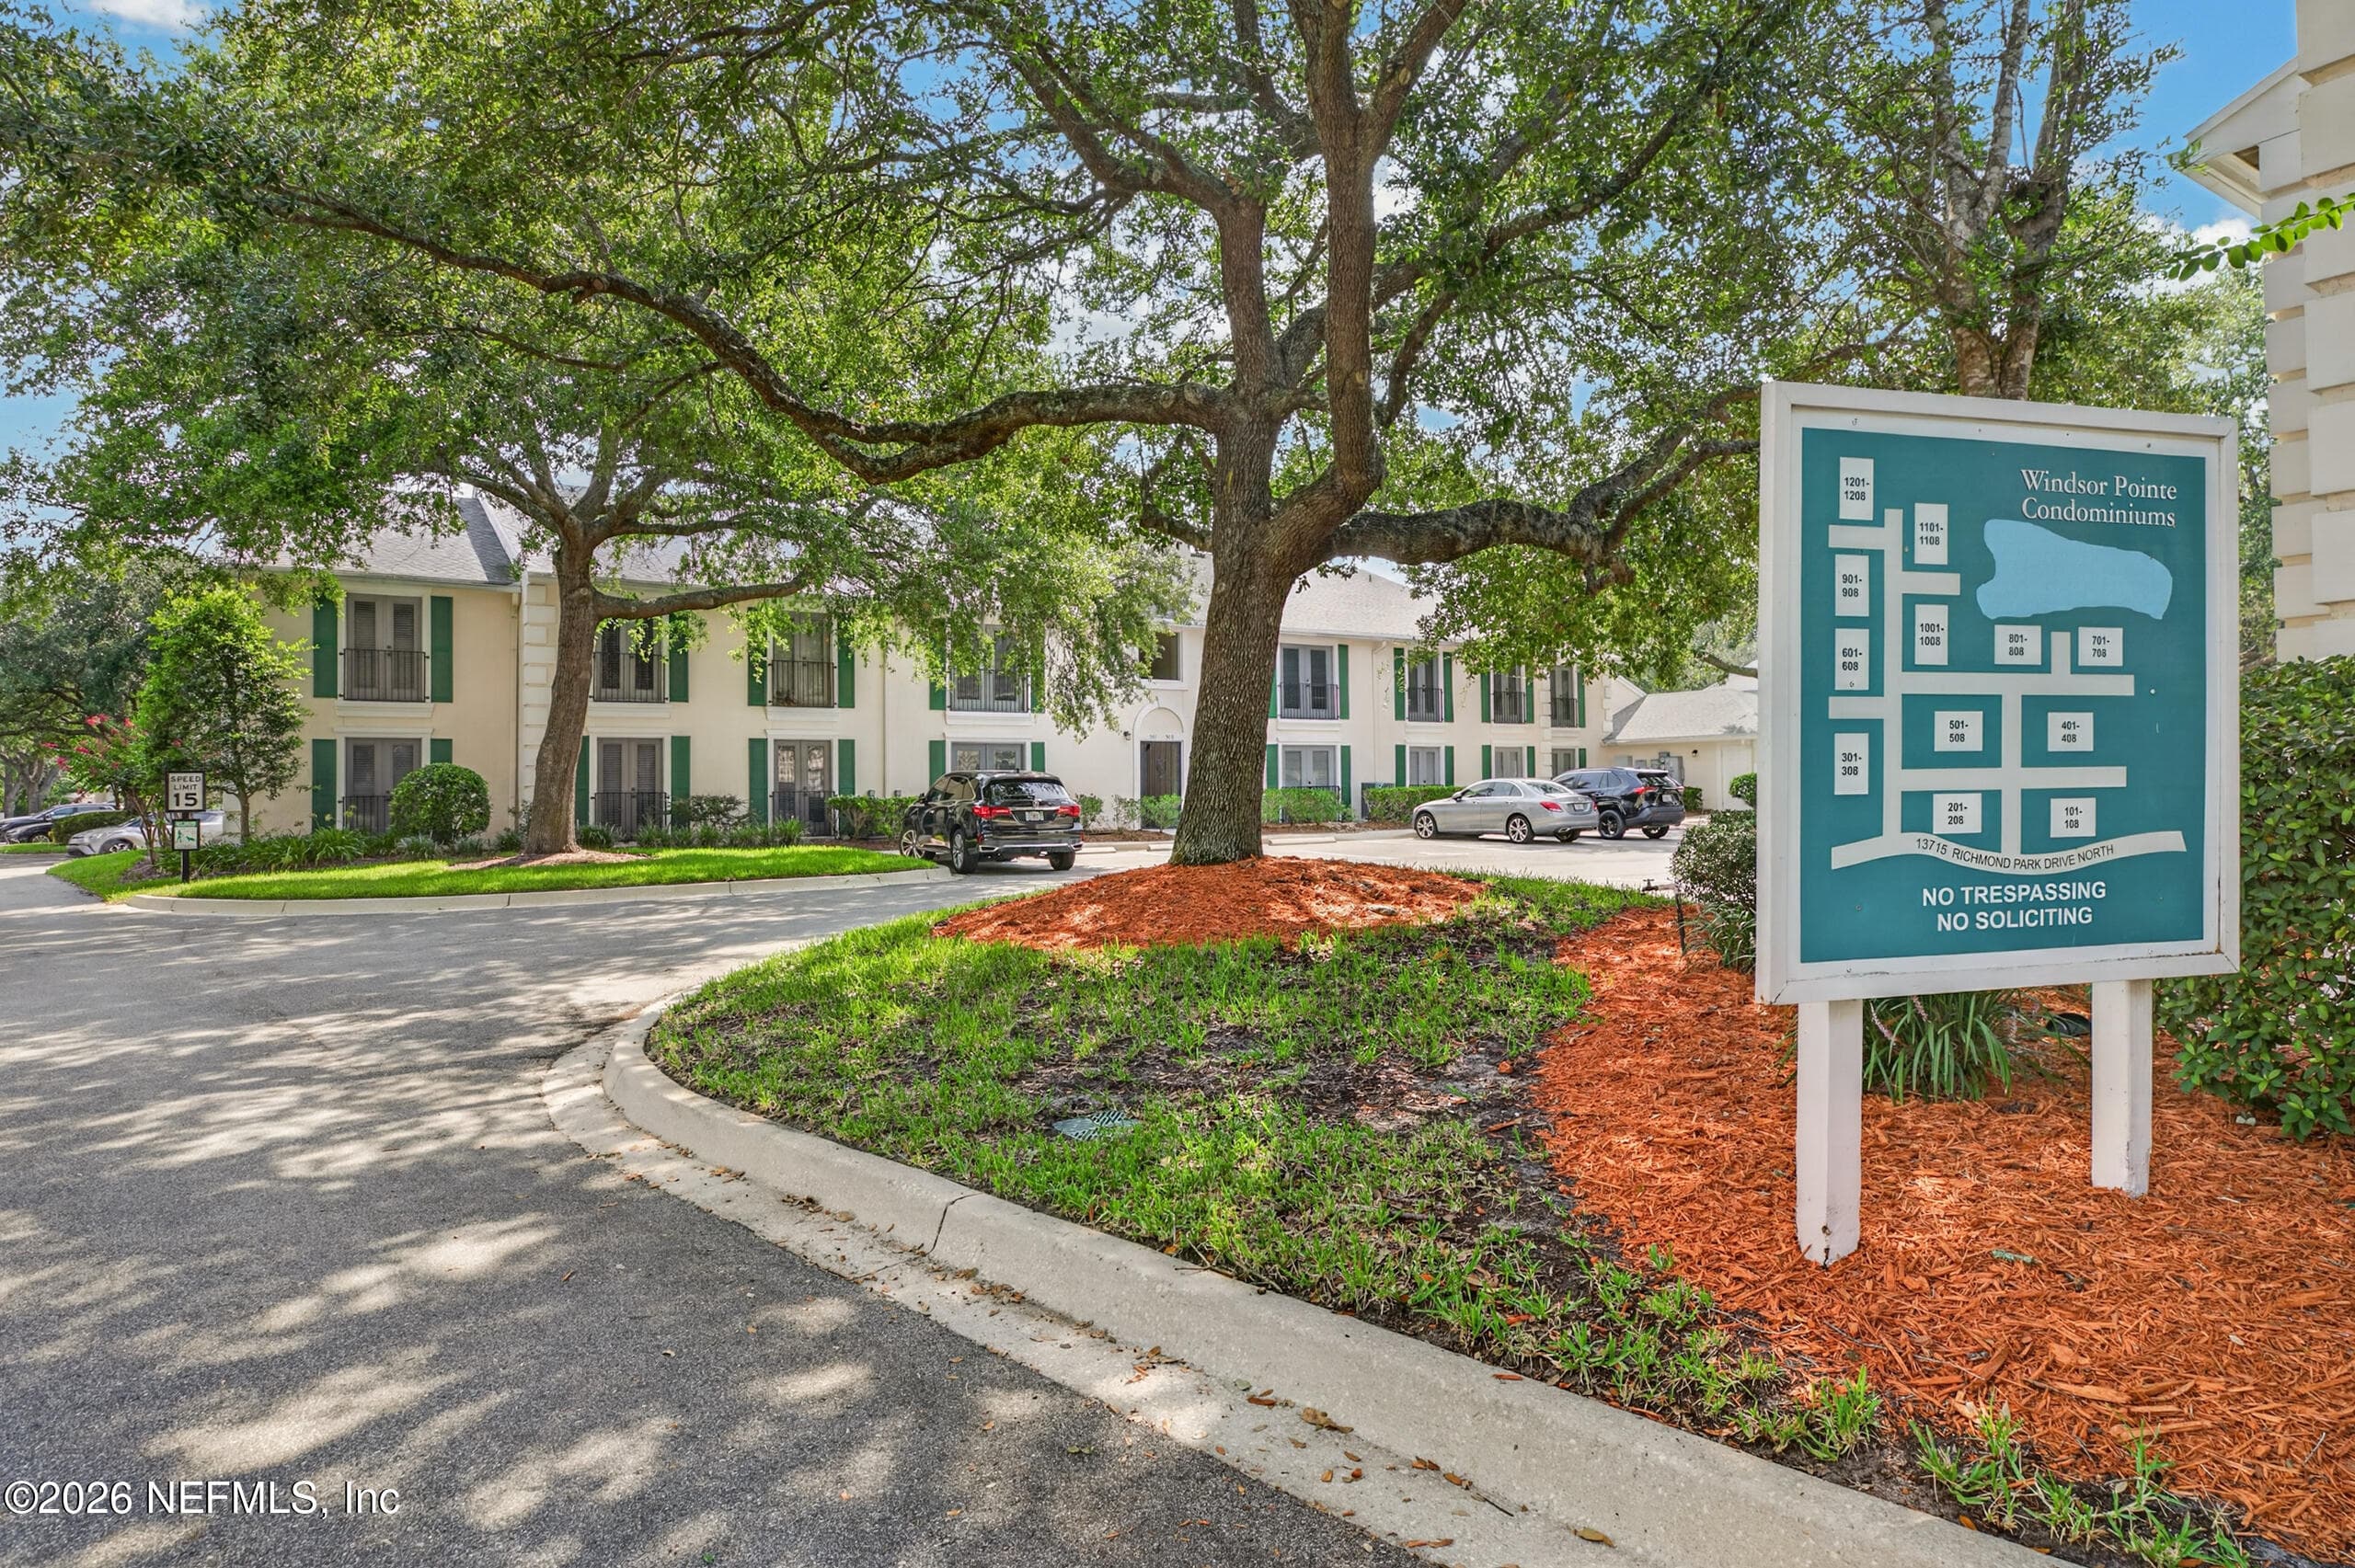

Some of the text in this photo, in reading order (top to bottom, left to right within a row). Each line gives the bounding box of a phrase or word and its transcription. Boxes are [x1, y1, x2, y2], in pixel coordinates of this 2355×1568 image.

[1844, 476, 1870, 487] 1201-
[2021, 469, 2177, 500] Windsor Pointe
[1844, 490, 1867, 501] 1208
[2021, 497, 2177, 528] Condominiums
[1919, 521, 1944, 532] 1101-
[1919, 535, 1941, 546] 1108
[1842, 573, 1863, 585] 901-
[1842, 587, 1859, 598] 908
[1919, 623, 1945, 634] 1001-
[1919, 635, 1941, 647] 1008
[2008, 633, 2028, 644] 801-
[2092, 635, 2110, 646] 701-
[1842, 647, 1863, 658] 601-
[2008, 646, 2025, 657] 808
[2092, 647, 2107, 658] 708
[1842, 660, 1859, 671] 608
[1948, 719, 1969, 730] 501-
[2061, 720, 2080, 731] 401-
[1948, 733, 1966, 743] 508
[2061, 733, 2077, 743] 408
[1841, 752, 1863, 762] 301-
[1841, 765, 1859, 776] 308
[173, 793, 198, 807] 15
[1947, 802, 1969, 812] 201-
[2064, 806, 2083, 817] 101-
[1947, 815, 1964, 825] 208
[2064, 818, 2080, 830] 108
[1915, 838, 2115, 870] 13715 RICHMOND PARK DRIVE NORTH
[1922, 881, 2107, 907] NO TRESPASSING
[1936, 906, 2093, 932] NO SOLICITING
